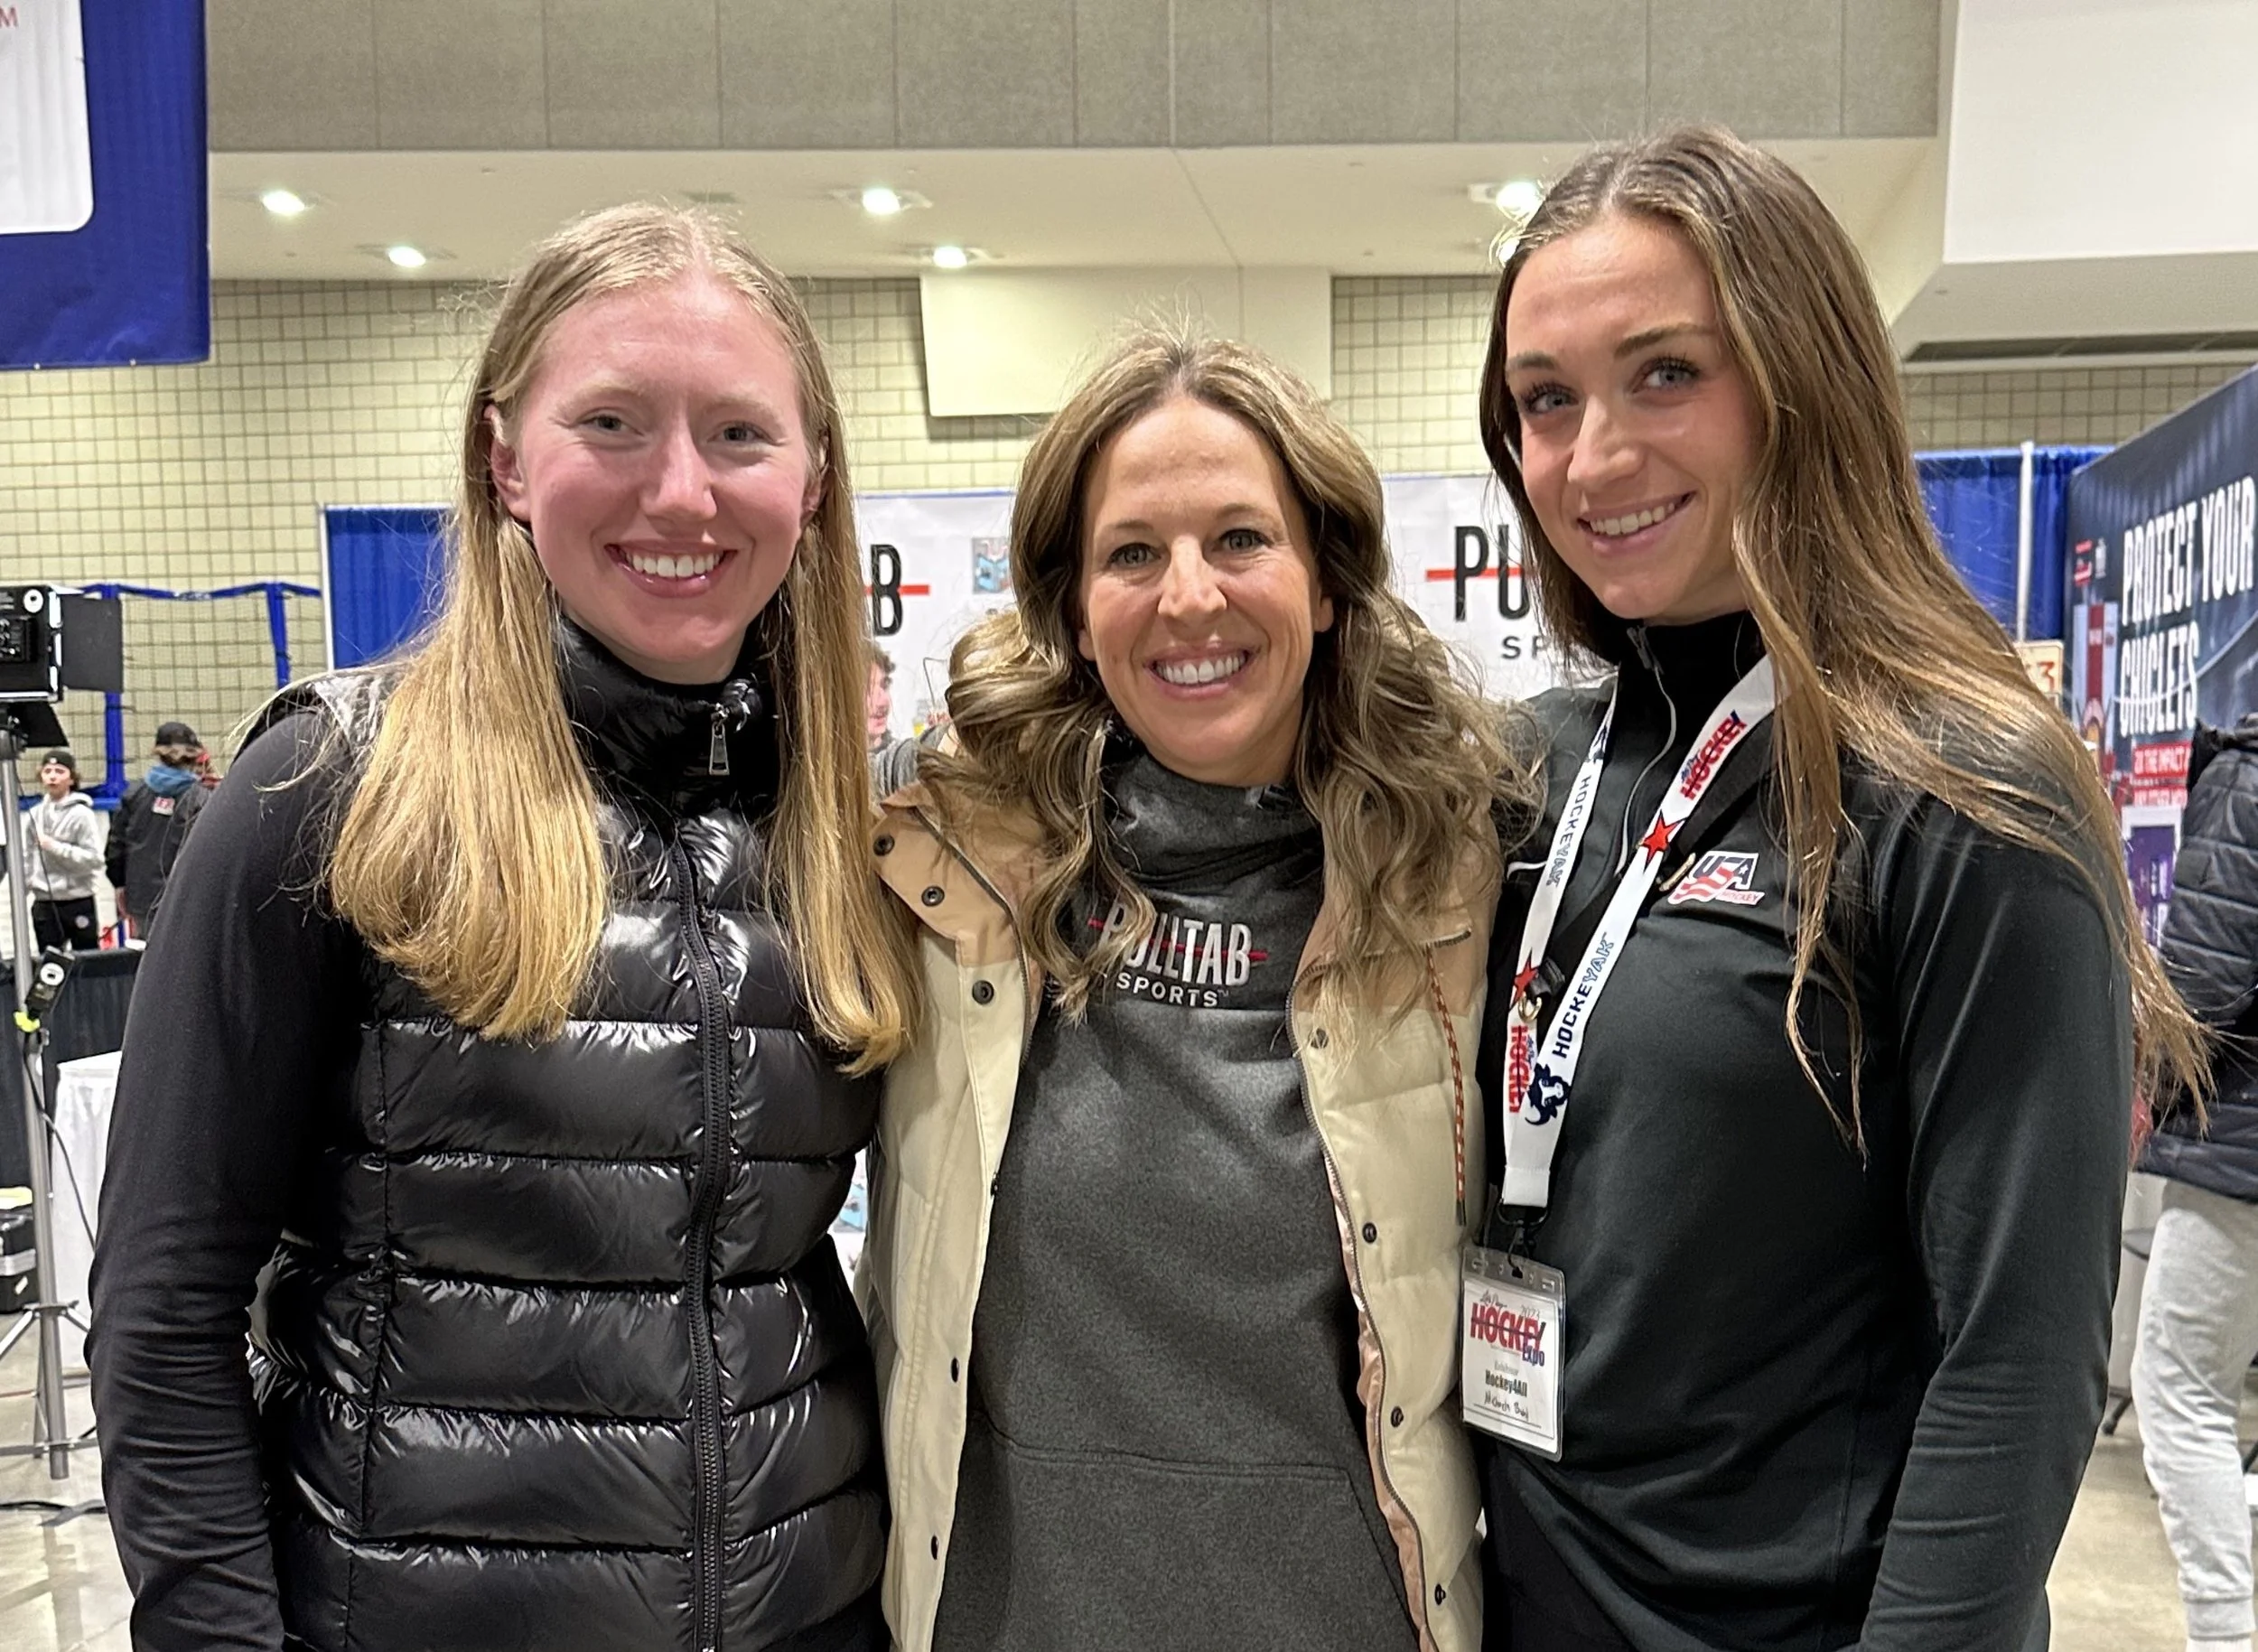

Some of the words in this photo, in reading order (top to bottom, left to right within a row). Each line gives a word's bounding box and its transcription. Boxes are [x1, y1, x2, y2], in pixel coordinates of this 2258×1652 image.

[2123, 501, 2197, 626] PROTECT
[2201, 475, 2256, 602] YOUR
[2120, 621, 2200, 737] CHICLETS
[1680, 709, 1748, 800] HOCKEY
[1116, 971, 1218, 1008] SPORTS
[1470, 1302, 1546, 1353] HOCKEY
